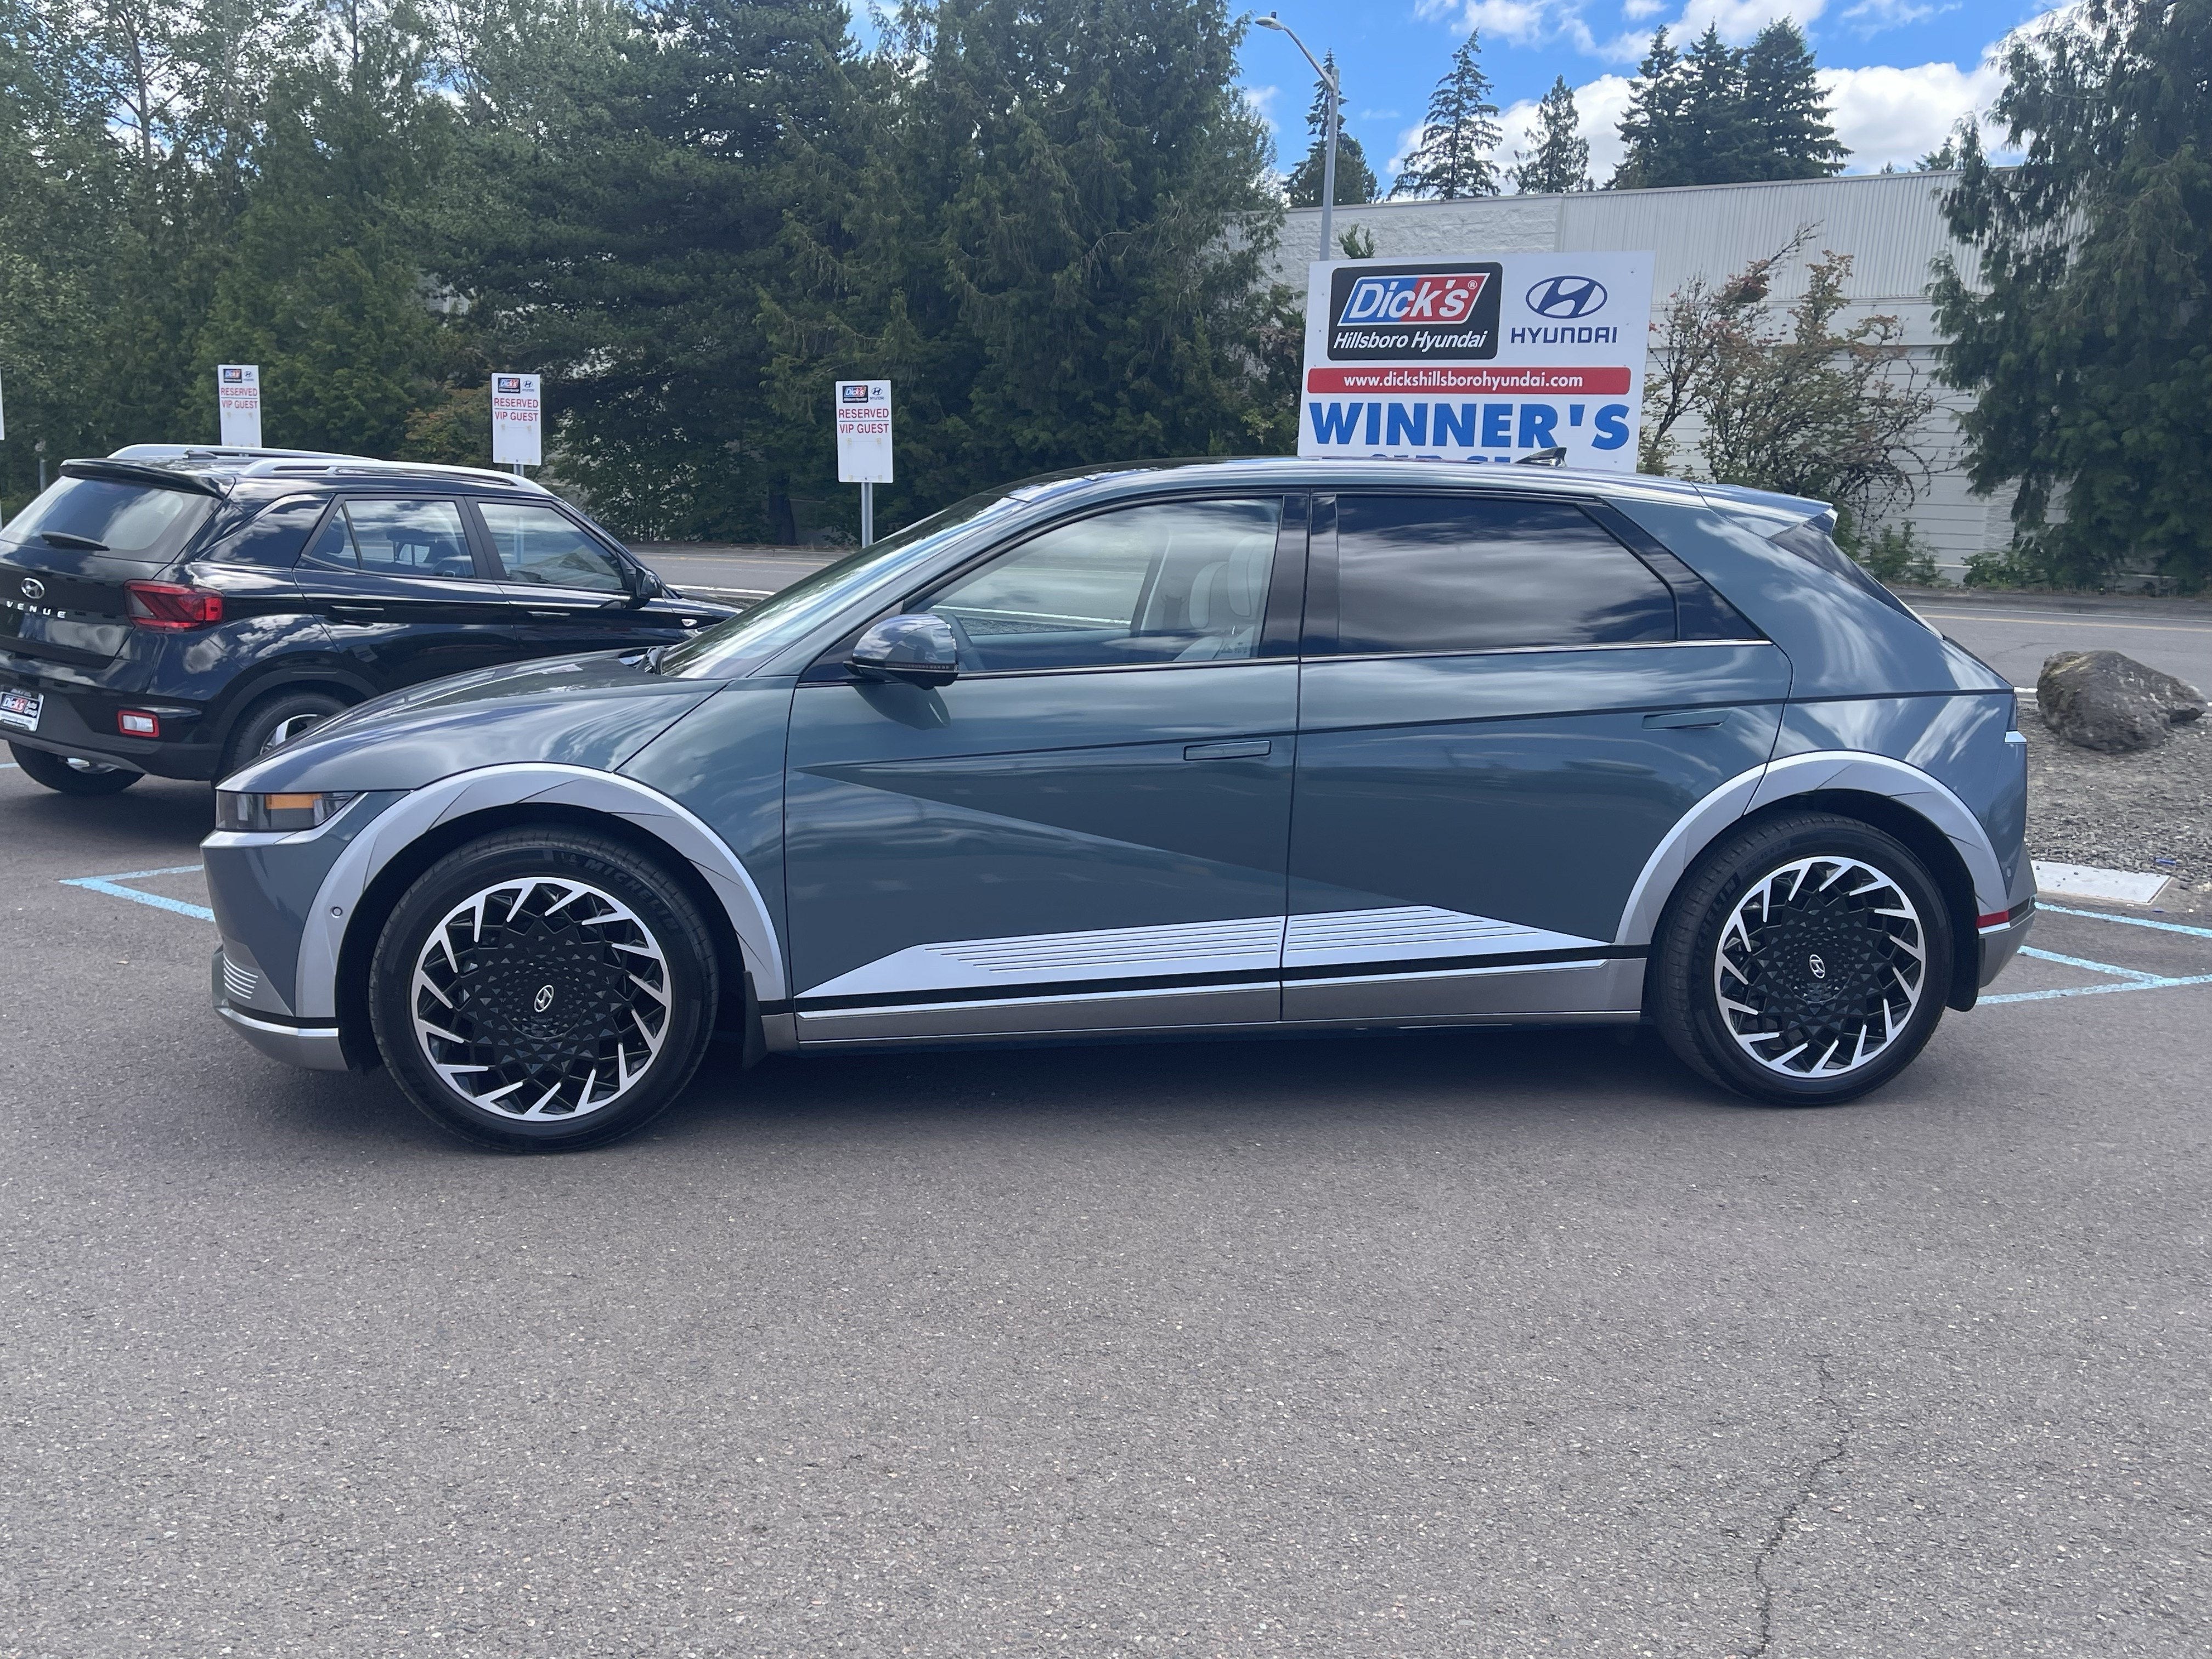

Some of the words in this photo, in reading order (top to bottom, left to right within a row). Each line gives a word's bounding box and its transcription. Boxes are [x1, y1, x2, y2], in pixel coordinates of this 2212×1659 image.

[1348, 280, 1470, 318] Dick's
[1333, 331, 1409, 348] Hillsboro
[1411, 330, 1488, 353] Hyundai
[1511, 327, 1617, 344] HYUNDAI
[1344, 371, 1583, 391] www.dickshillsborohyundai.com
[221, 387, 258, 396] RESERVED
[222, 400, 233, 408] VIP
[234, 400, 258, 409] GUEST
[494, 398, 538, 408] RESERVED
[495, 411, 507, 420] VIP
[510, 412, 538, 421] GUEST
[839, 408, 889, 419] RESERVED
[839, 424, 854, 433] VIP
[857, 424, 889, 433] GUEST
[1309, 402, 1630, 450] WINNER'S
[6, 600, 66, 618] VENUE
[583, 858, 679, 931] MICHELIN
